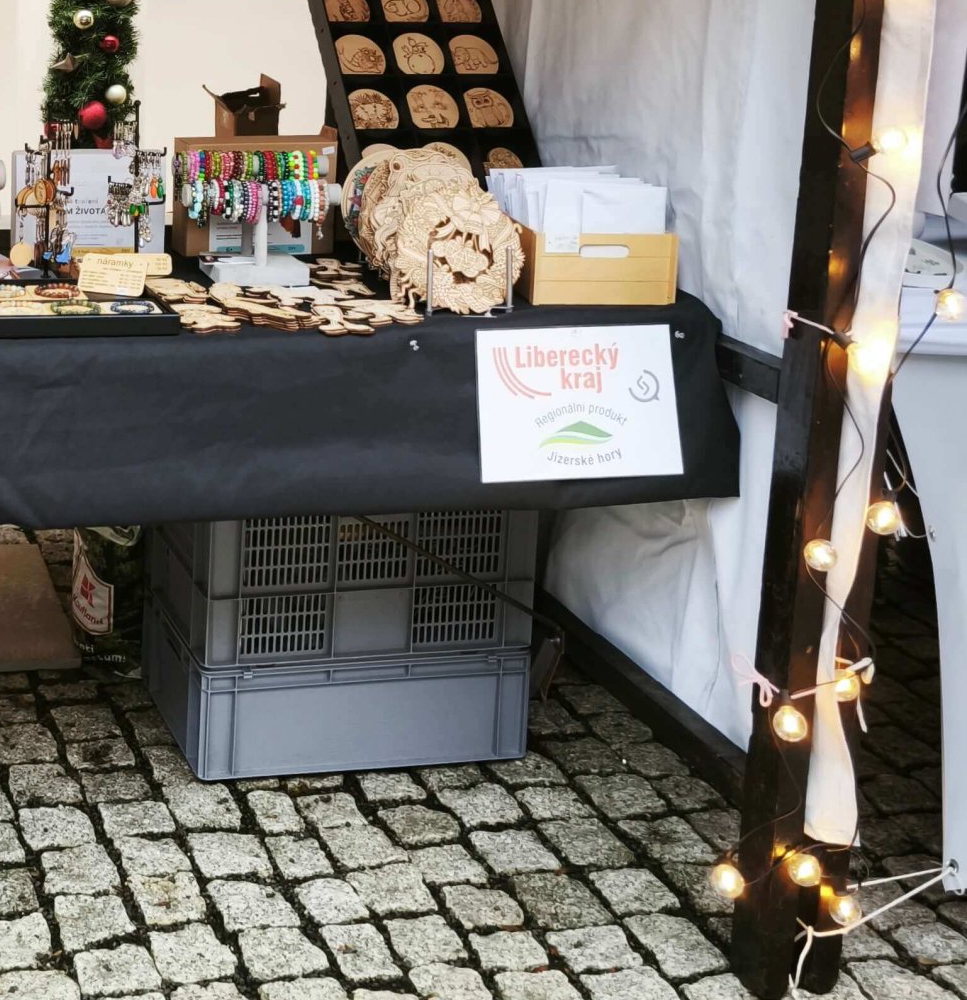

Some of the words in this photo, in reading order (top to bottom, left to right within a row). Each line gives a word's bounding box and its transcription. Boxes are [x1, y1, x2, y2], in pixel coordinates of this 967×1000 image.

[75, 206, 106, 214] ŽIVOTA
[97, 256, 134, 268] náramky
[514, 342, 619, 370] Liberecký
[560, 366, 603, 394] kraj
[534, 402, 586, 428] Regionální
[588, 403, 628, 428] produkt
[546, 450, 594, 466] Jizerské
[597, 448, 623, 464] hory
